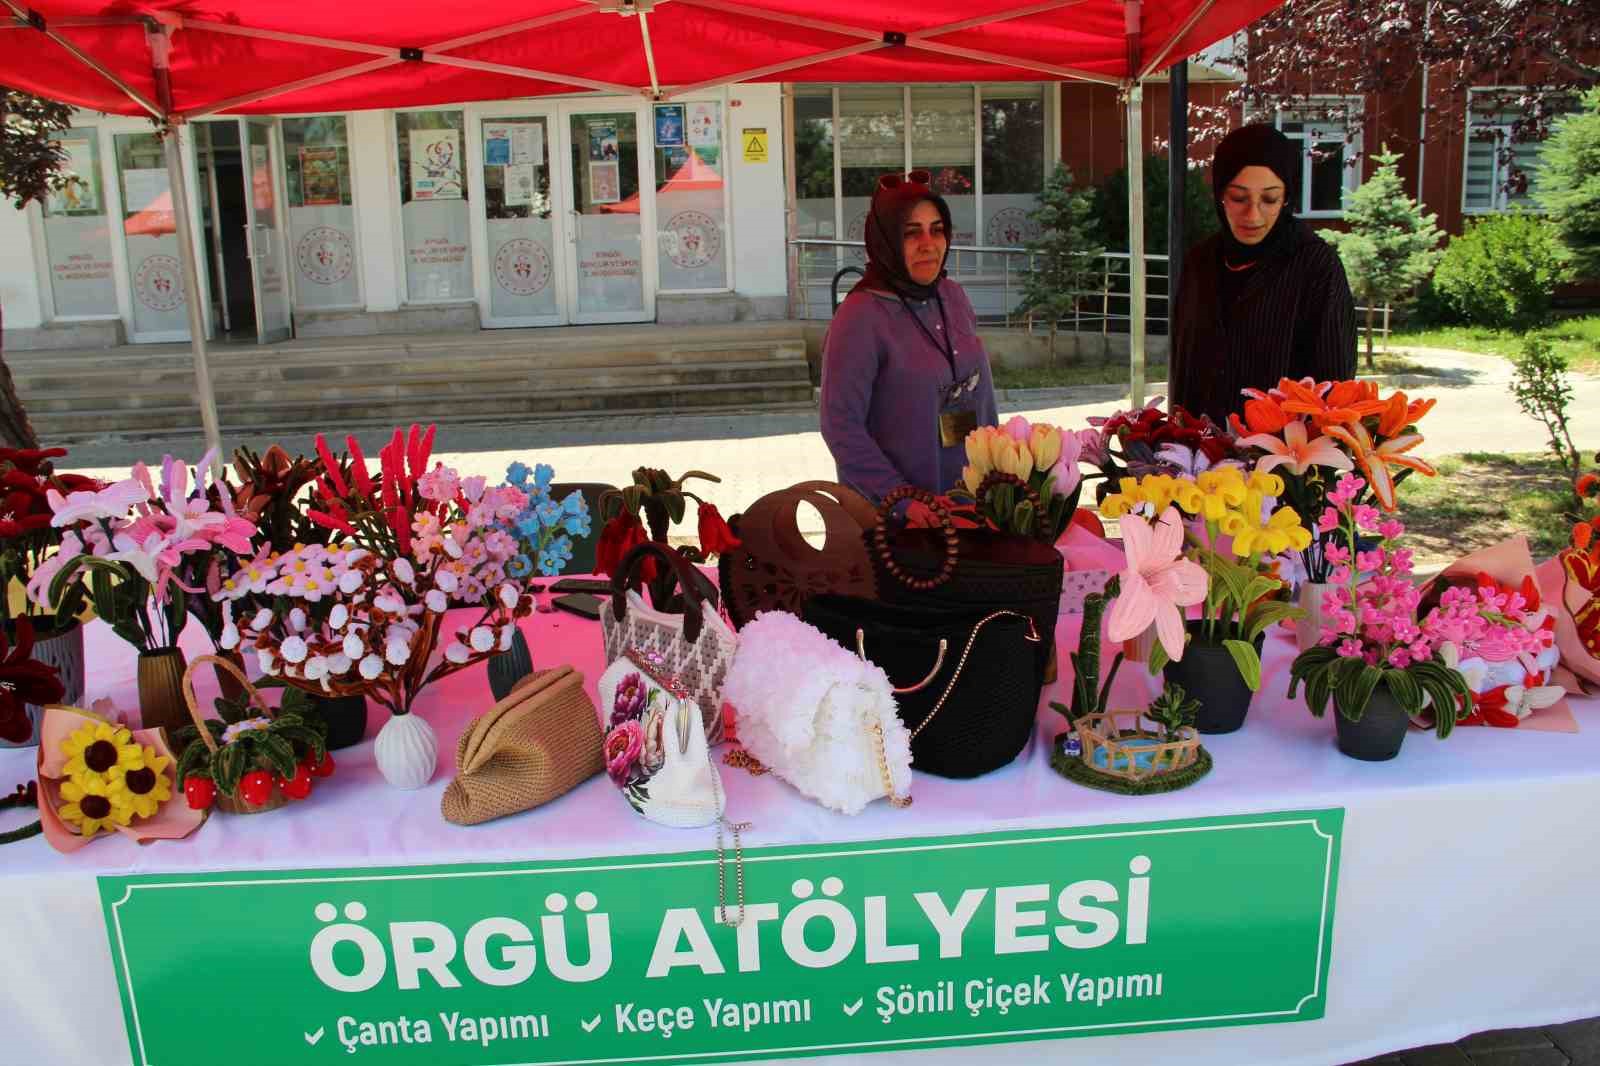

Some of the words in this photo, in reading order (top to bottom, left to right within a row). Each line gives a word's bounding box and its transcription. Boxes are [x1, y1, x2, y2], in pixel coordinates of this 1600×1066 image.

[310, 892, 613, 993] ÖRGÜ
[645, 856, 1152, 977] ATÖLYESİ
[615, 1004, 694, 1038] Keçe
[704, 998, 811, 1031] Yapımı
[876, 981, 954, 1023] Şönil
[965, 976, 1051, 1017] Çiçek
[1061, 972, 1163, 1006] Yapımı
[337, 1017, 432, 1053] Çanta
[440, 1013, 549, 1046] Yapımı
